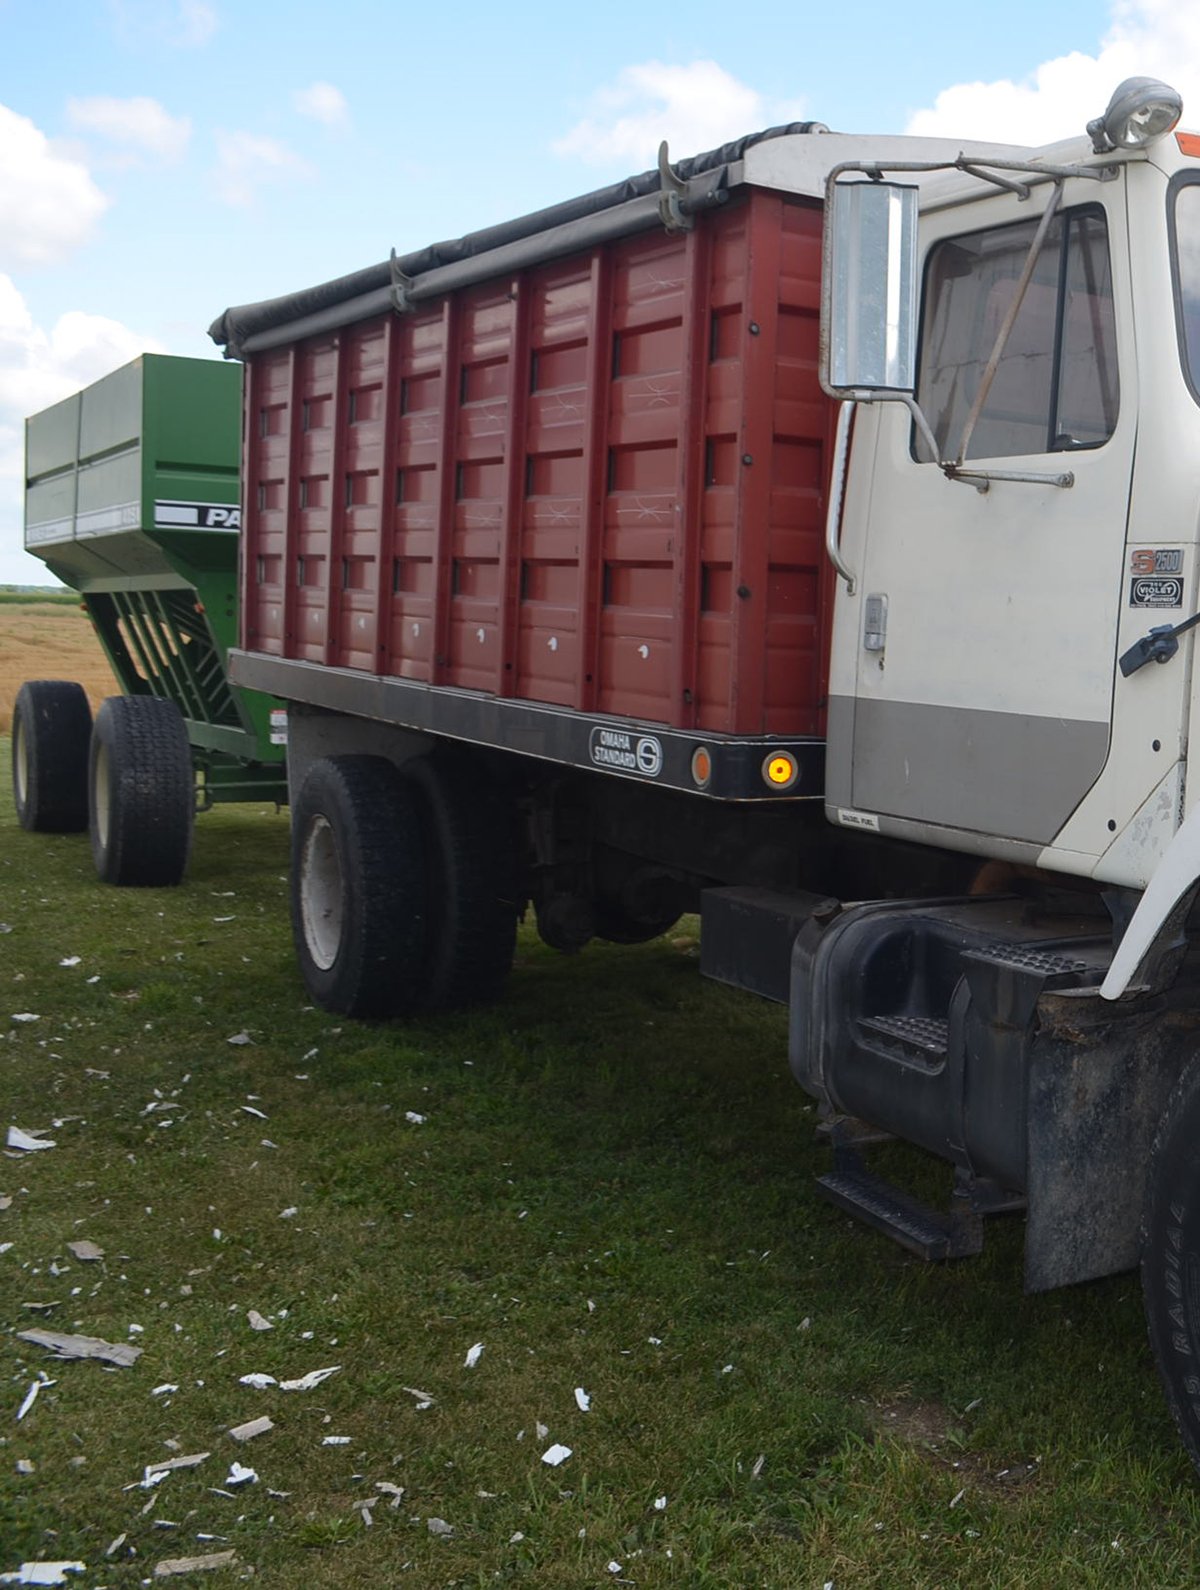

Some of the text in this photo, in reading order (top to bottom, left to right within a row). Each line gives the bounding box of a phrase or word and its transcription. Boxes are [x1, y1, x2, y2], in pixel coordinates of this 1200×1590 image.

[599, 731, 631, 750] OMAHA
[594, 746, 636, 769] STANDARD
[1163, 1199, 1193, 1357] RADIAL
